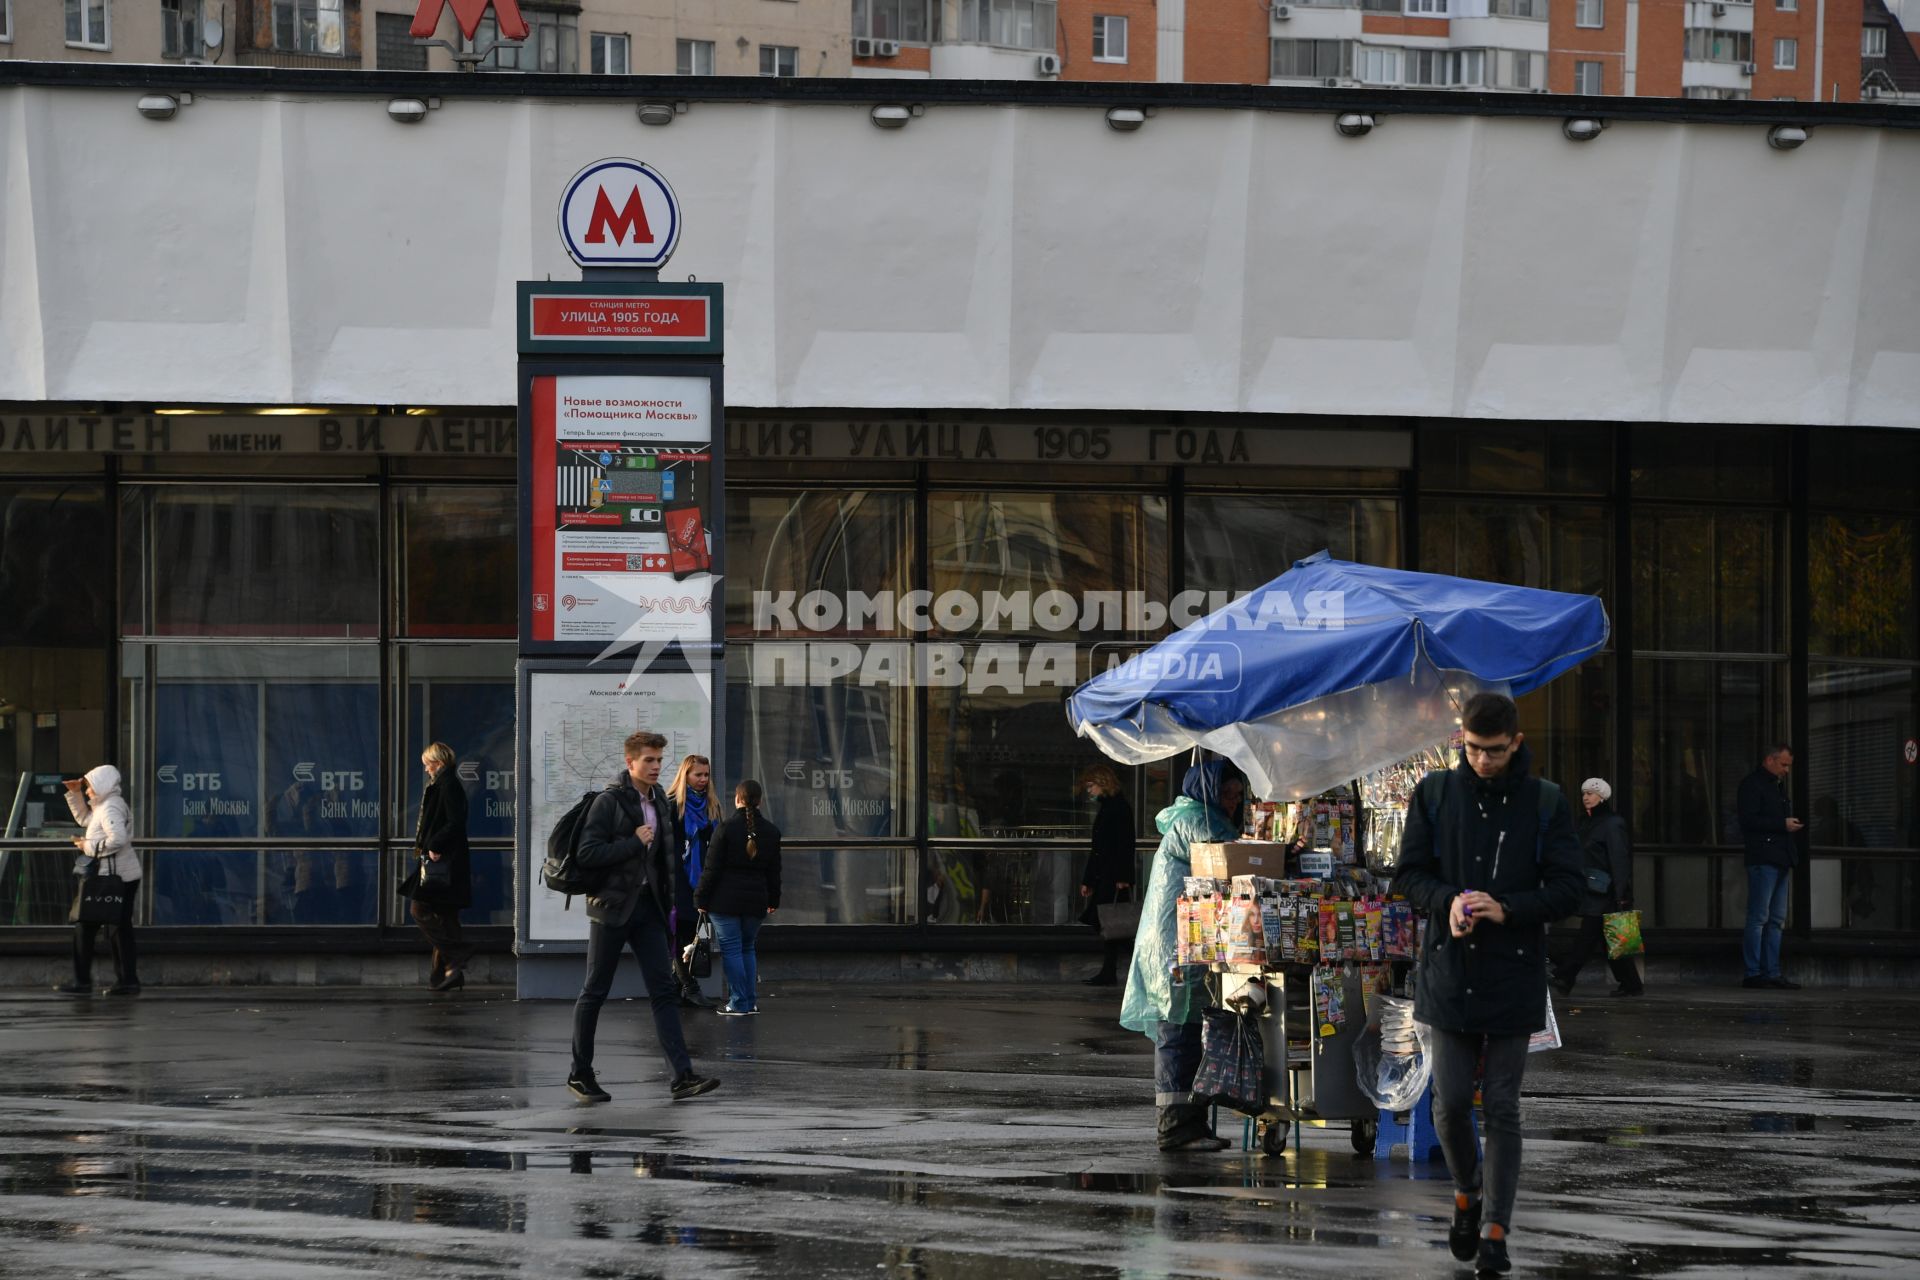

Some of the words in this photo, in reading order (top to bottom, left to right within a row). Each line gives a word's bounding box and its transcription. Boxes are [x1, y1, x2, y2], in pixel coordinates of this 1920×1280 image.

[584, 183, 654, 247] М
[590, 302, 624, 310] СТАНЦИЯ
[561, 312, 607, 323] УЛИЦА
[611, 312, 639, 323] 1905
[644, 312, 680, 324] ГОДА
[631, 326, 653, 334] GODA
[564, 396, 602, 407] Новые
[605, 399, 683, 408] возможности
[563, 408, 642, 420] «Помощника
[645, 409, 698, 420] Москвы»
[0, 417, 172, 451] ЛИТЕН
[208, 434, 282, 451] ИМЕНИ
[563, 429, 585, 437] Теперь
[848, 423, 997, 459] УЛИЦА
[1034, 426, 1112, 460] 1905
[1149, 428, 1250, 464] ГОДА
[183, 773, 222, 791] ВТБ
[321, 771, 364, 791] ВТБ
[812, 769, 854, 789] ВТБ
[183, 798, 207, 816] Банк
[210, 797, 250, 816] Москвы
[321, 799, 348, 818] Банк
[485, 797, 513, 817] Банк
[812, 796, 838, 816] Банк
[841, 796, 885, 816] Москвы
[85, 895, 123, 904] AVON
